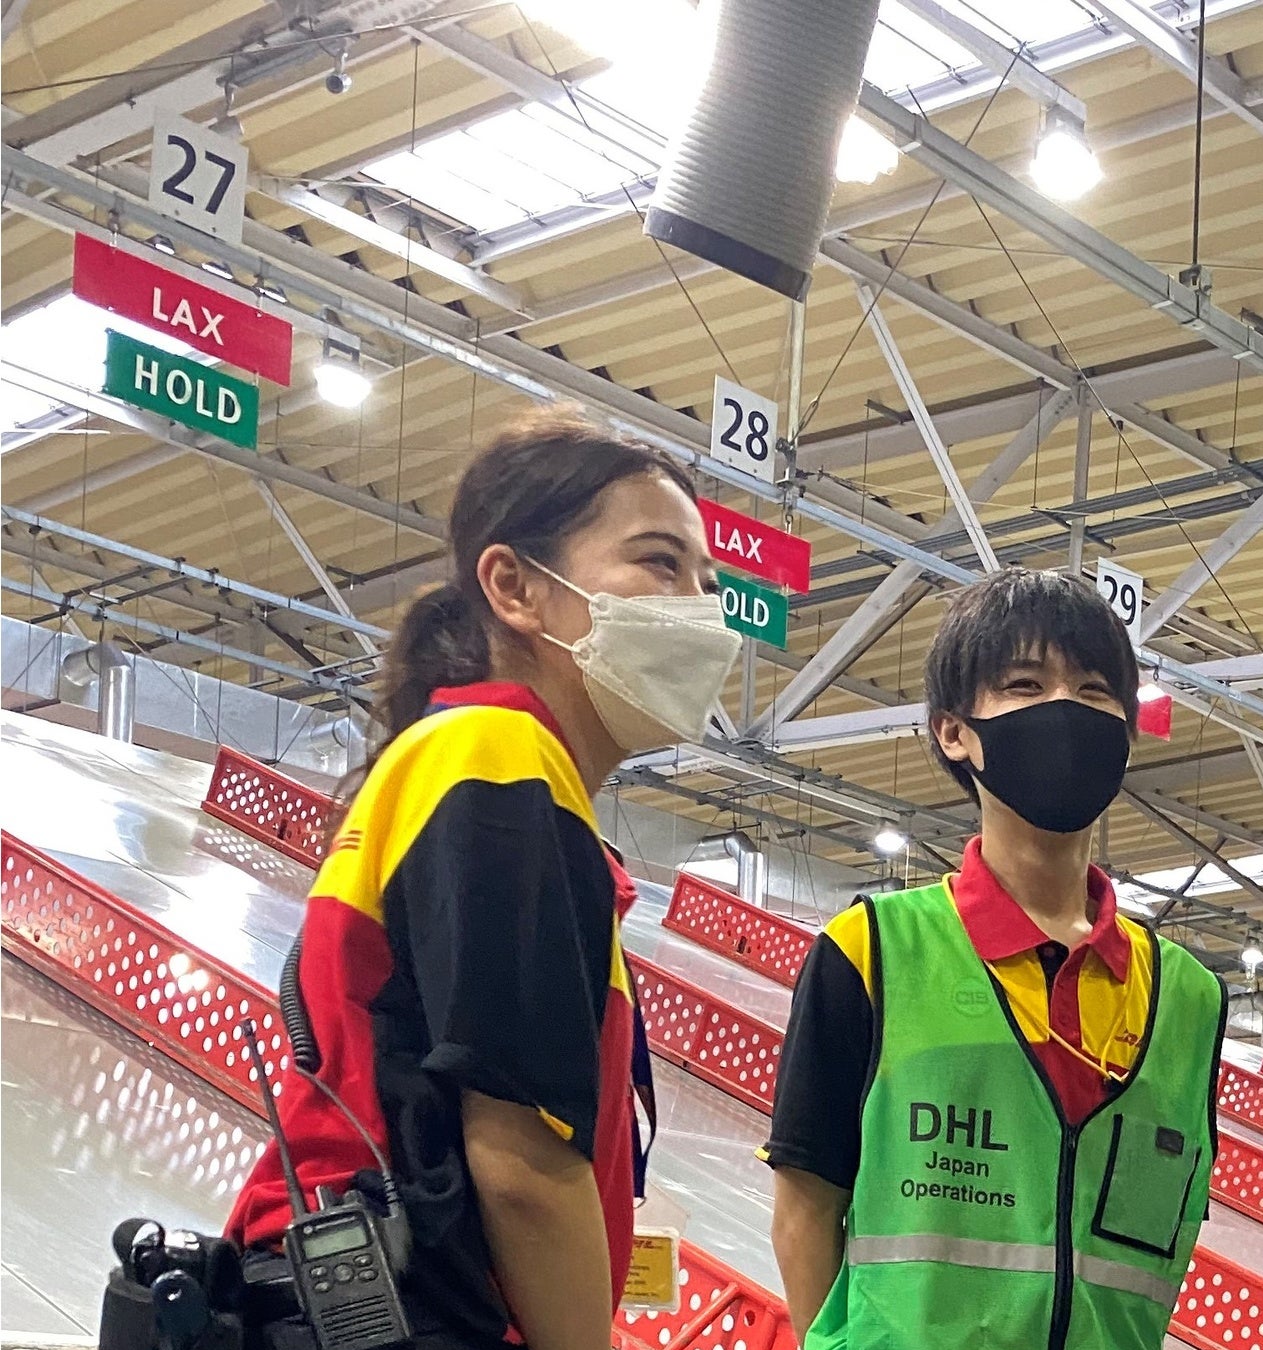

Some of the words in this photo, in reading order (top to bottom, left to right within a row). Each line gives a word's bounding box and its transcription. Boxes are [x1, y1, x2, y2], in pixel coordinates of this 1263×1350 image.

[162, 134, 236, 215] 27
[152, 286, 225, 346] LAX
[134, 353, 242, 424] HOLD
[720, 397, 769, 461] 28
[714, 520, 763, 564] LAX
[721, 586, 770, 627] OLD
[1103, 574, 1137, 625] 29
[909, 1102, 1009, 1152] DHL
[925, 1150, 990, 1178] Japan
[900, 1178, 1016, 1208] Operations
